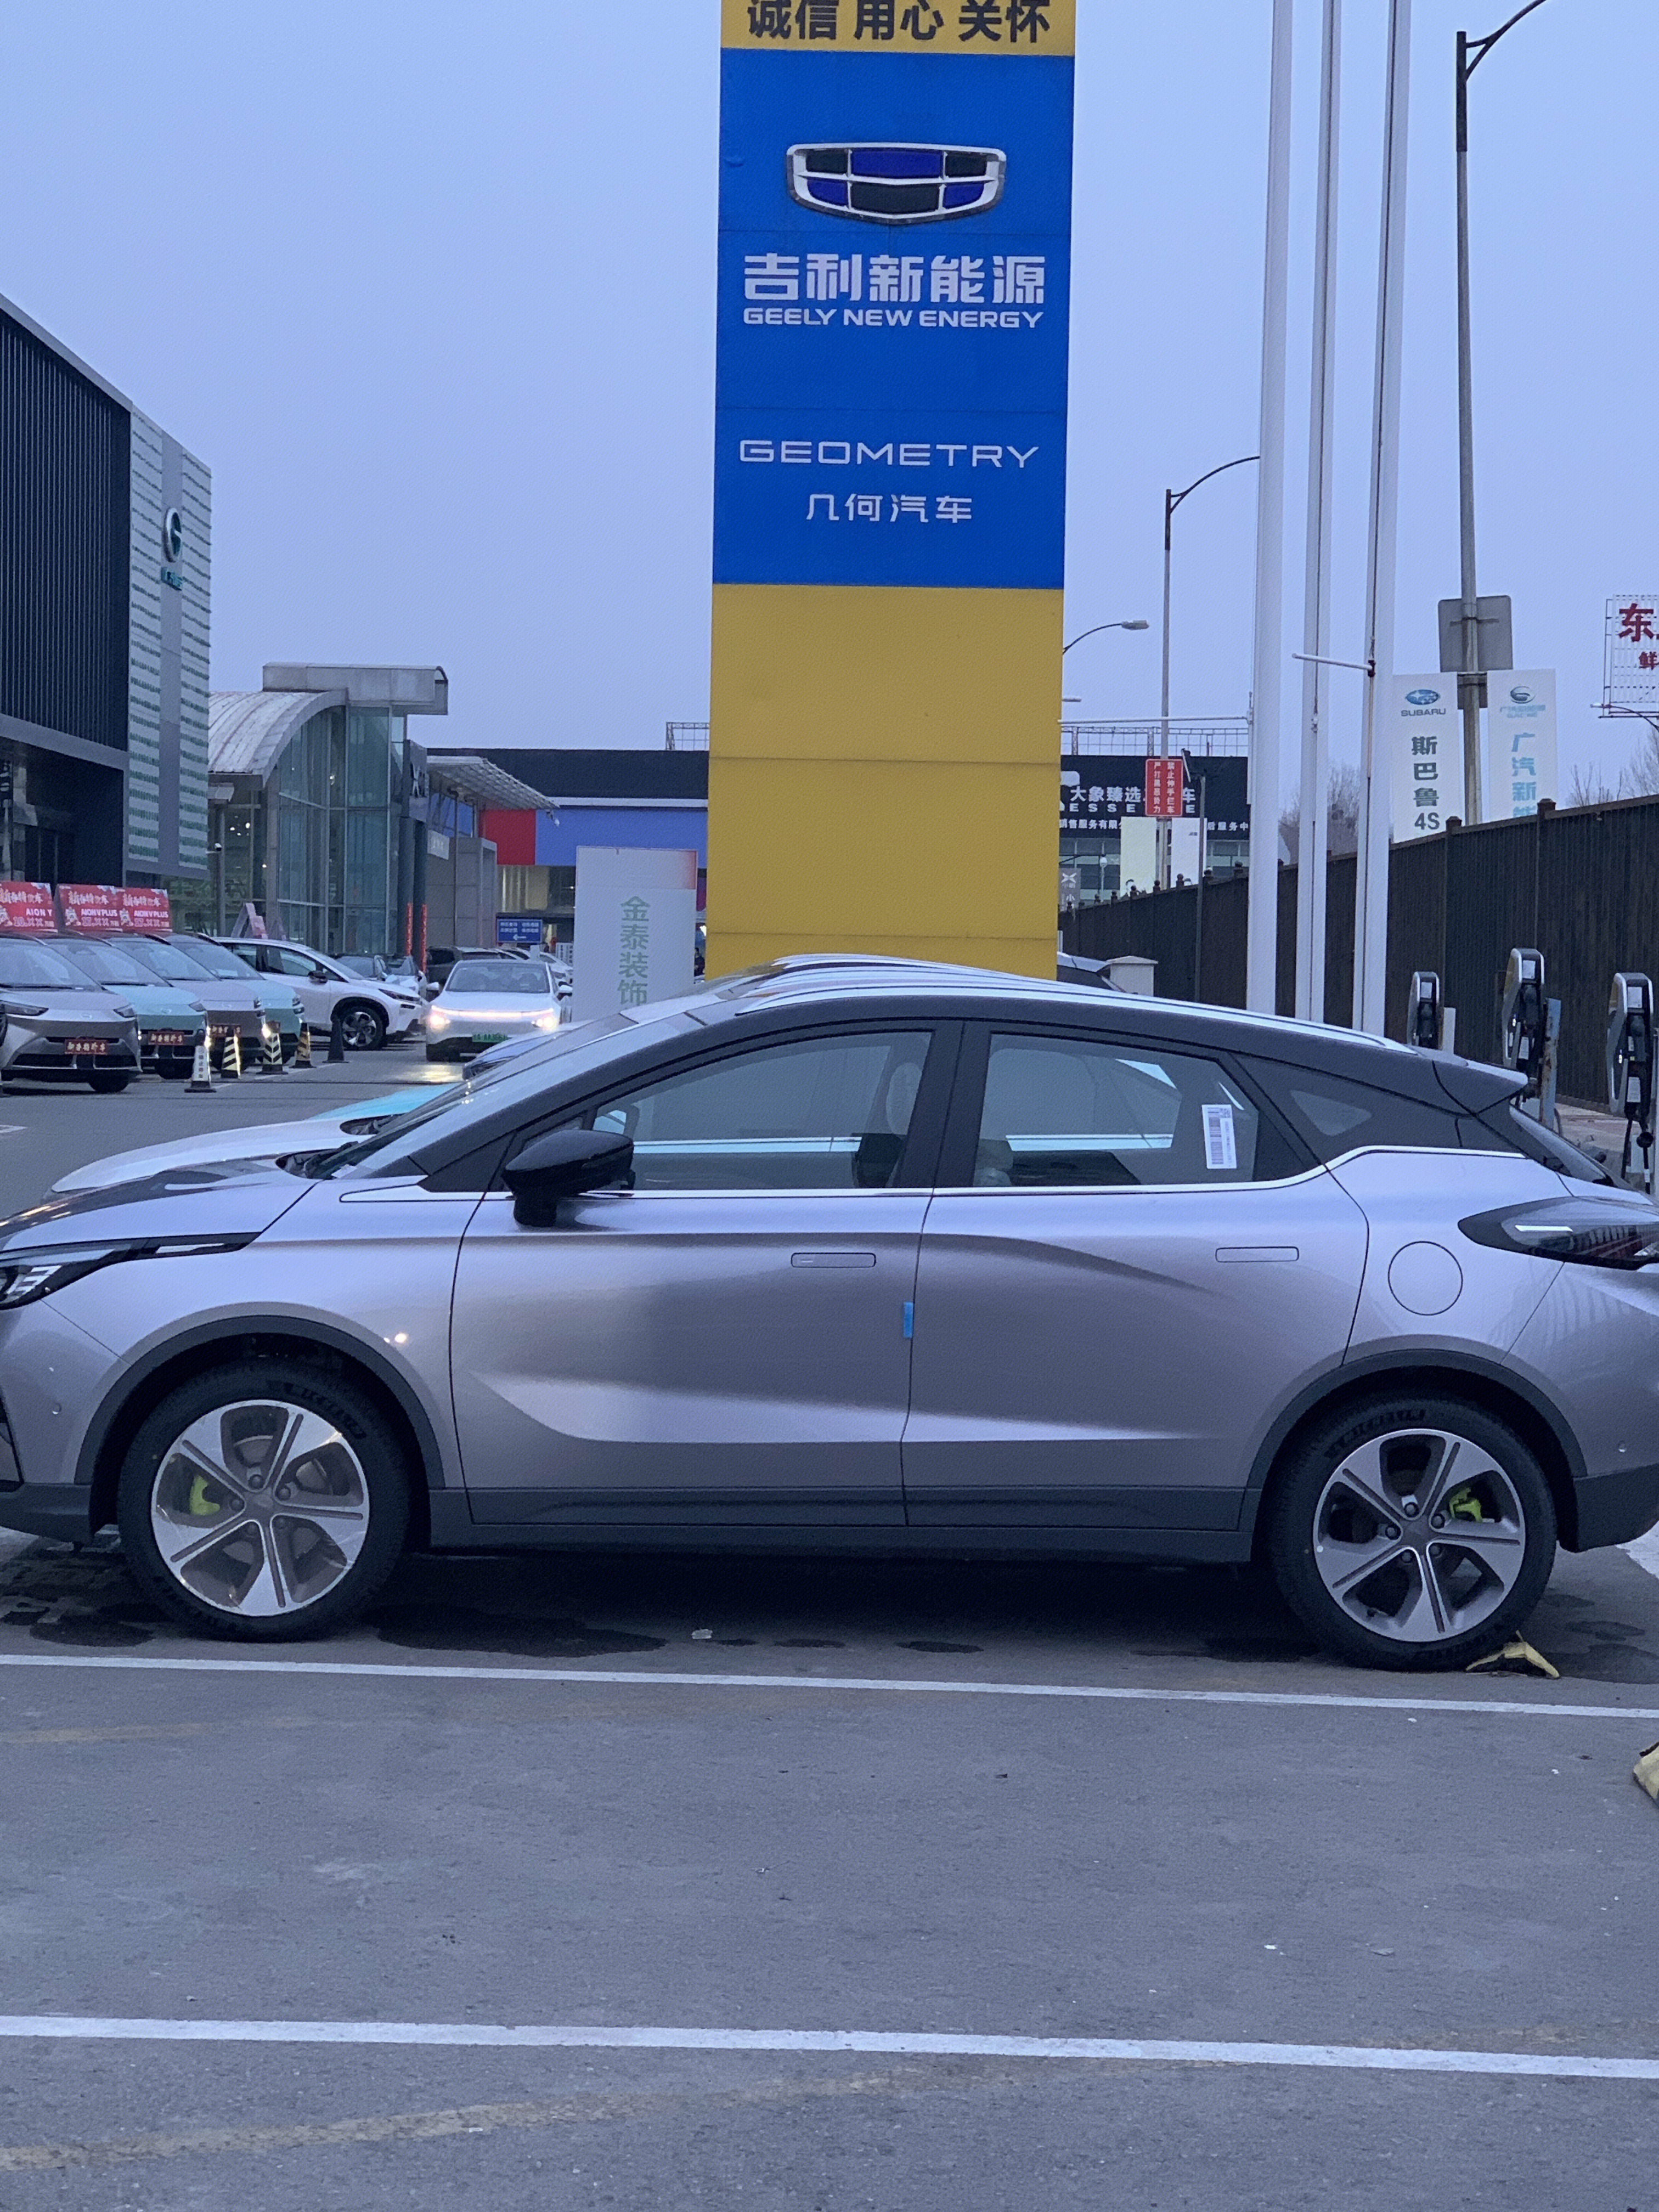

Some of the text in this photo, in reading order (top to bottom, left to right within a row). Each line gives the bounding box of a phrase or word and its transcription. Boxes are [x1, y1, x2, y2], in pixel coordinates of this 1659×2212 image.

[747, 0, 1050, 43] 诚信 用心 关怀
[744, 252, 1045, 304] 吉利新能源
[743, 308, 1044, 328] GEELY NEW ENERGY
[740, 439, 1039, 468] GEOMETRY
[806, 493, 972, 523] 几何汽车
[1619, 603, 1659, 642] 东
[1401, 708, 1447, 716] SUBARU
[26, 908, 46, 916] AION
[617, 896, 651, 1007] 金泰装饰
